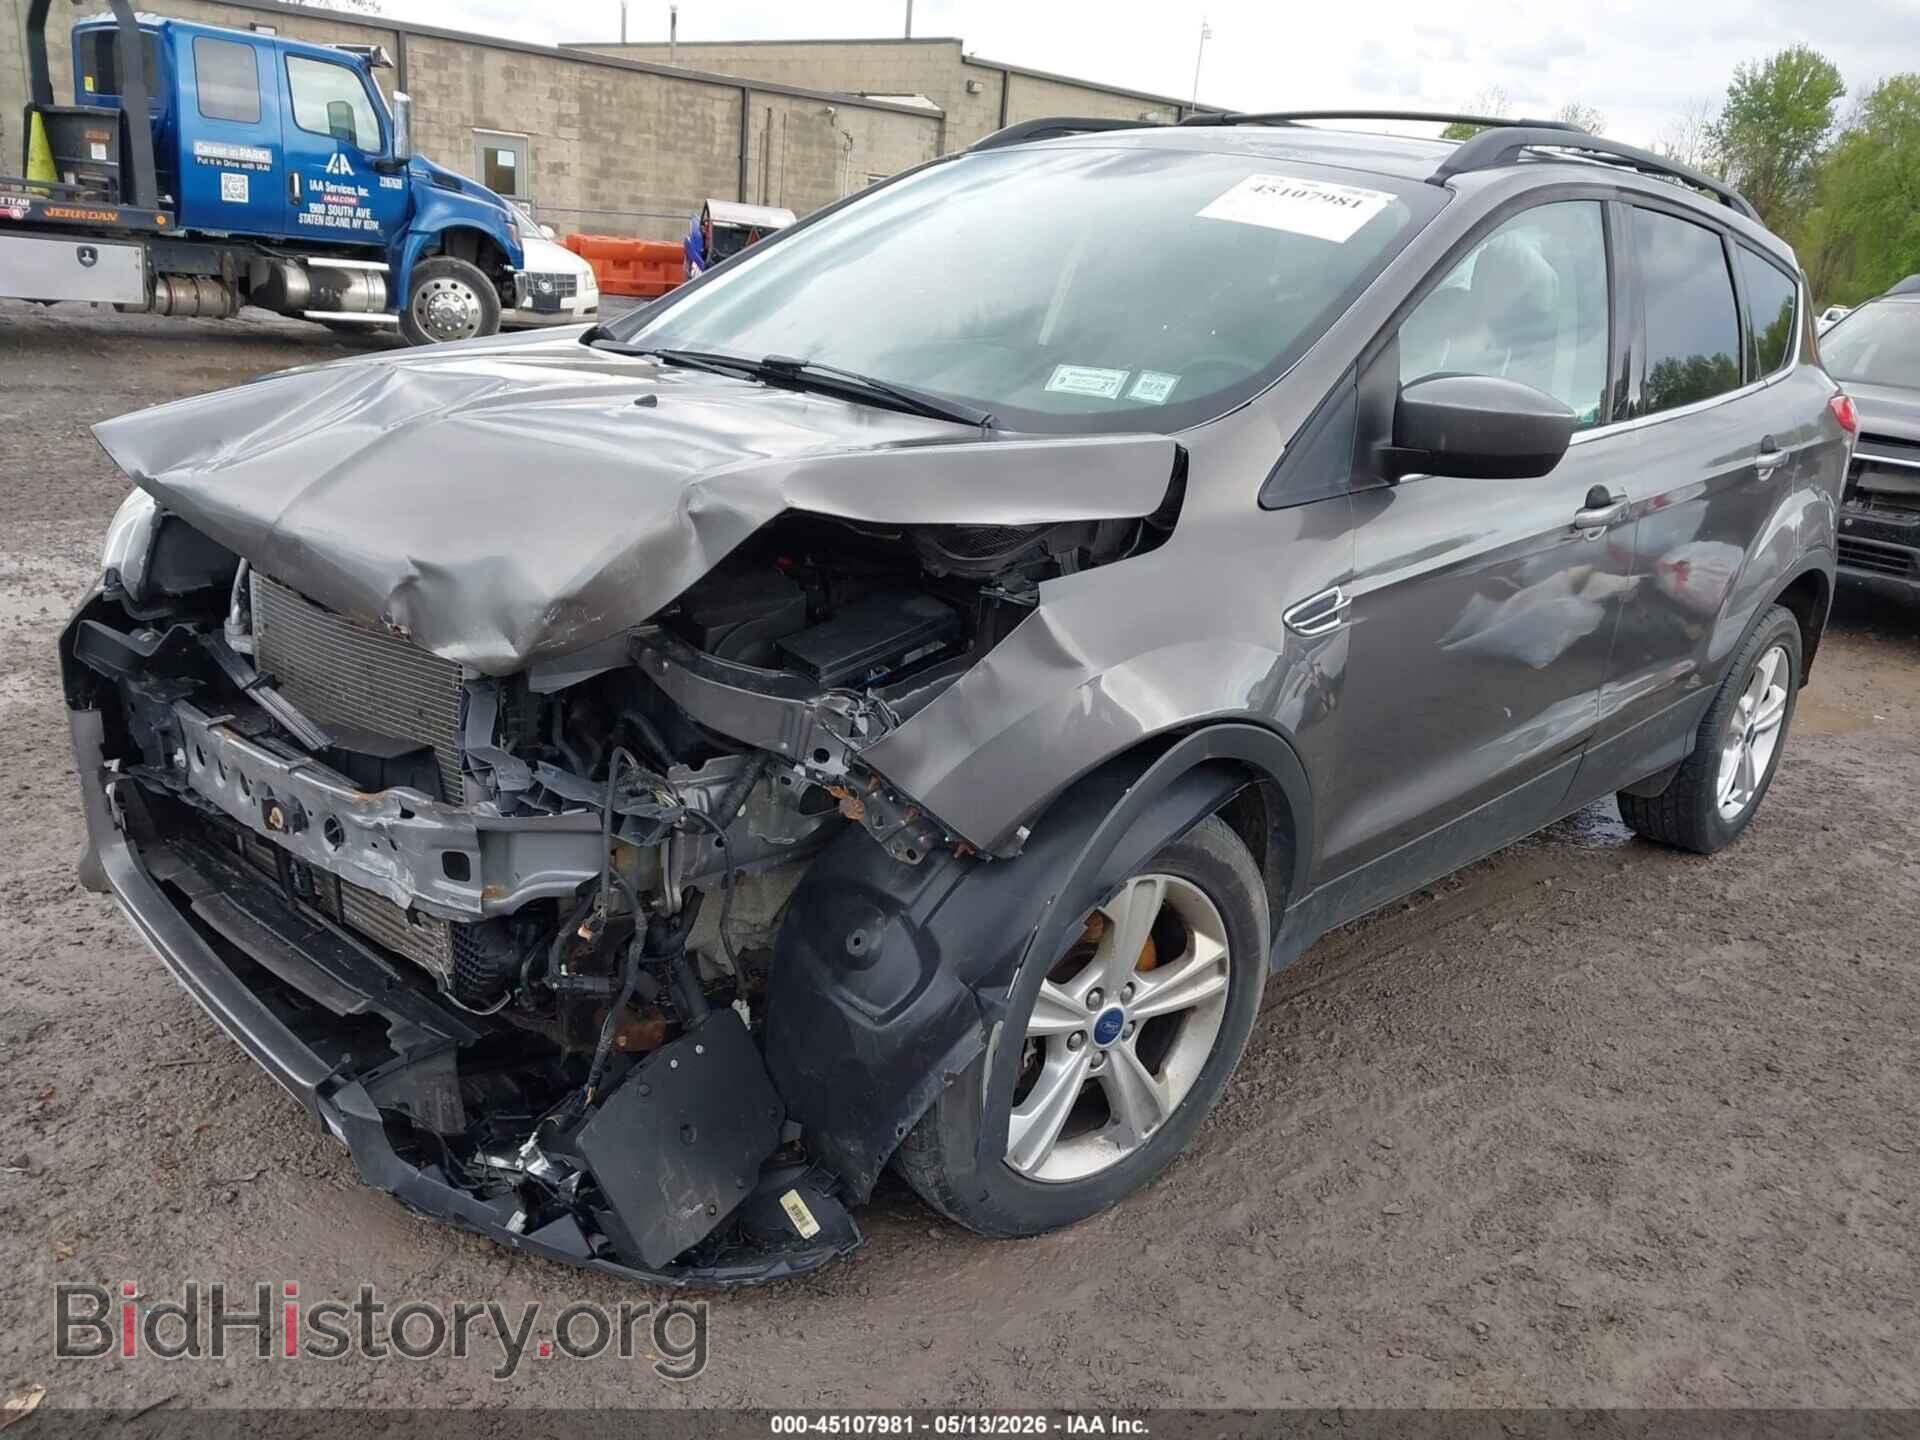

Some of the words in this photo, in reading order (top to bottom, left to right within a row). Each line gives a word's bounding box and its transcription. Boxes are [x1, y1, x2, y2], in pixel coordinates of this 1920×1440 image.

[223, 159, 240, 169] Drive
[309, 179, 324, 191] IAA
[7, 197, 30, 206] TEAM
[1249, 184, 1363, 209] 45107981
[327, 204, 354, 217] SOUTH
[355, 207, 372, 219] AVE
[298, 212, 324, 226] STATEN
[351, 217, 362, 229] NY
